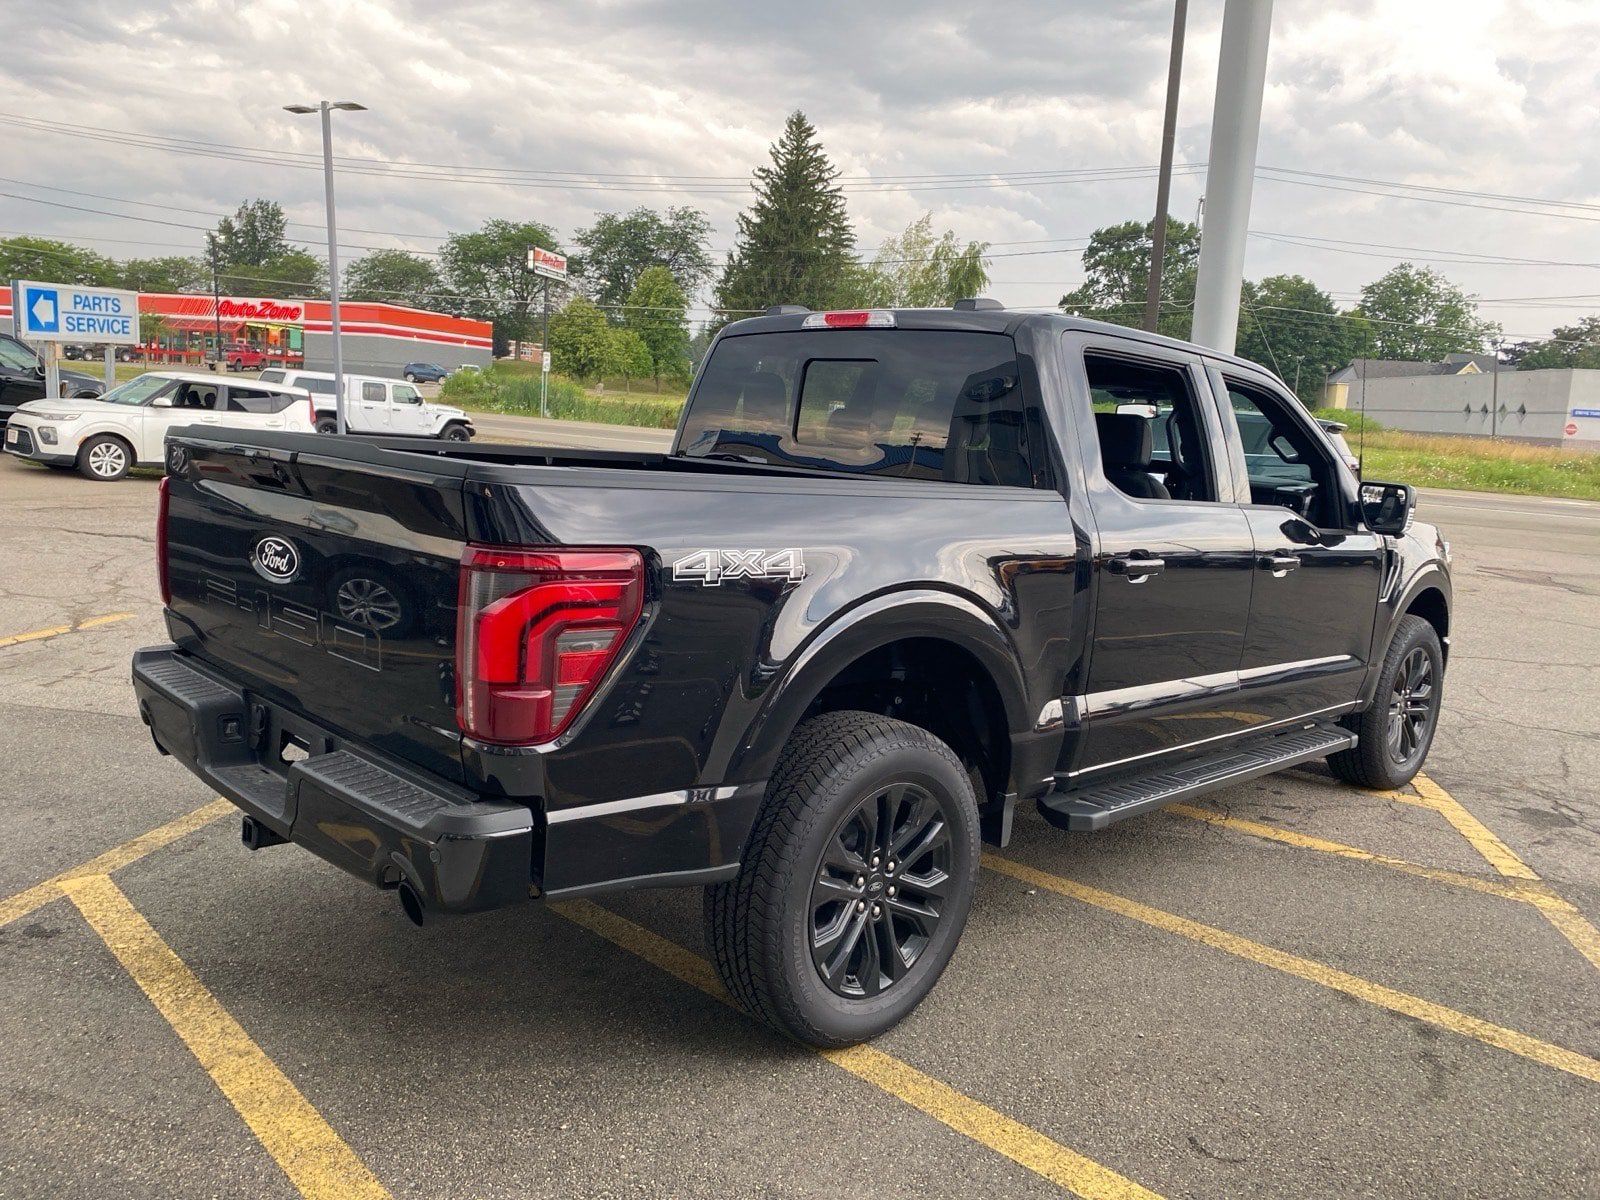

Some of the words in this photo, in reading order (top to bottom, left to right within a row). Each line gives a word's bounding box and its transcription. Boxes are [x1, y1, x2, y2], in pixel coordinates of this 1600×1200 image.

[73, 294, 121, 313] PARTS
[219, 300, 301, 320] AutoZone
[66, 316, 130, 335] SERVICE
[262, 541, 290, 572] Ford
